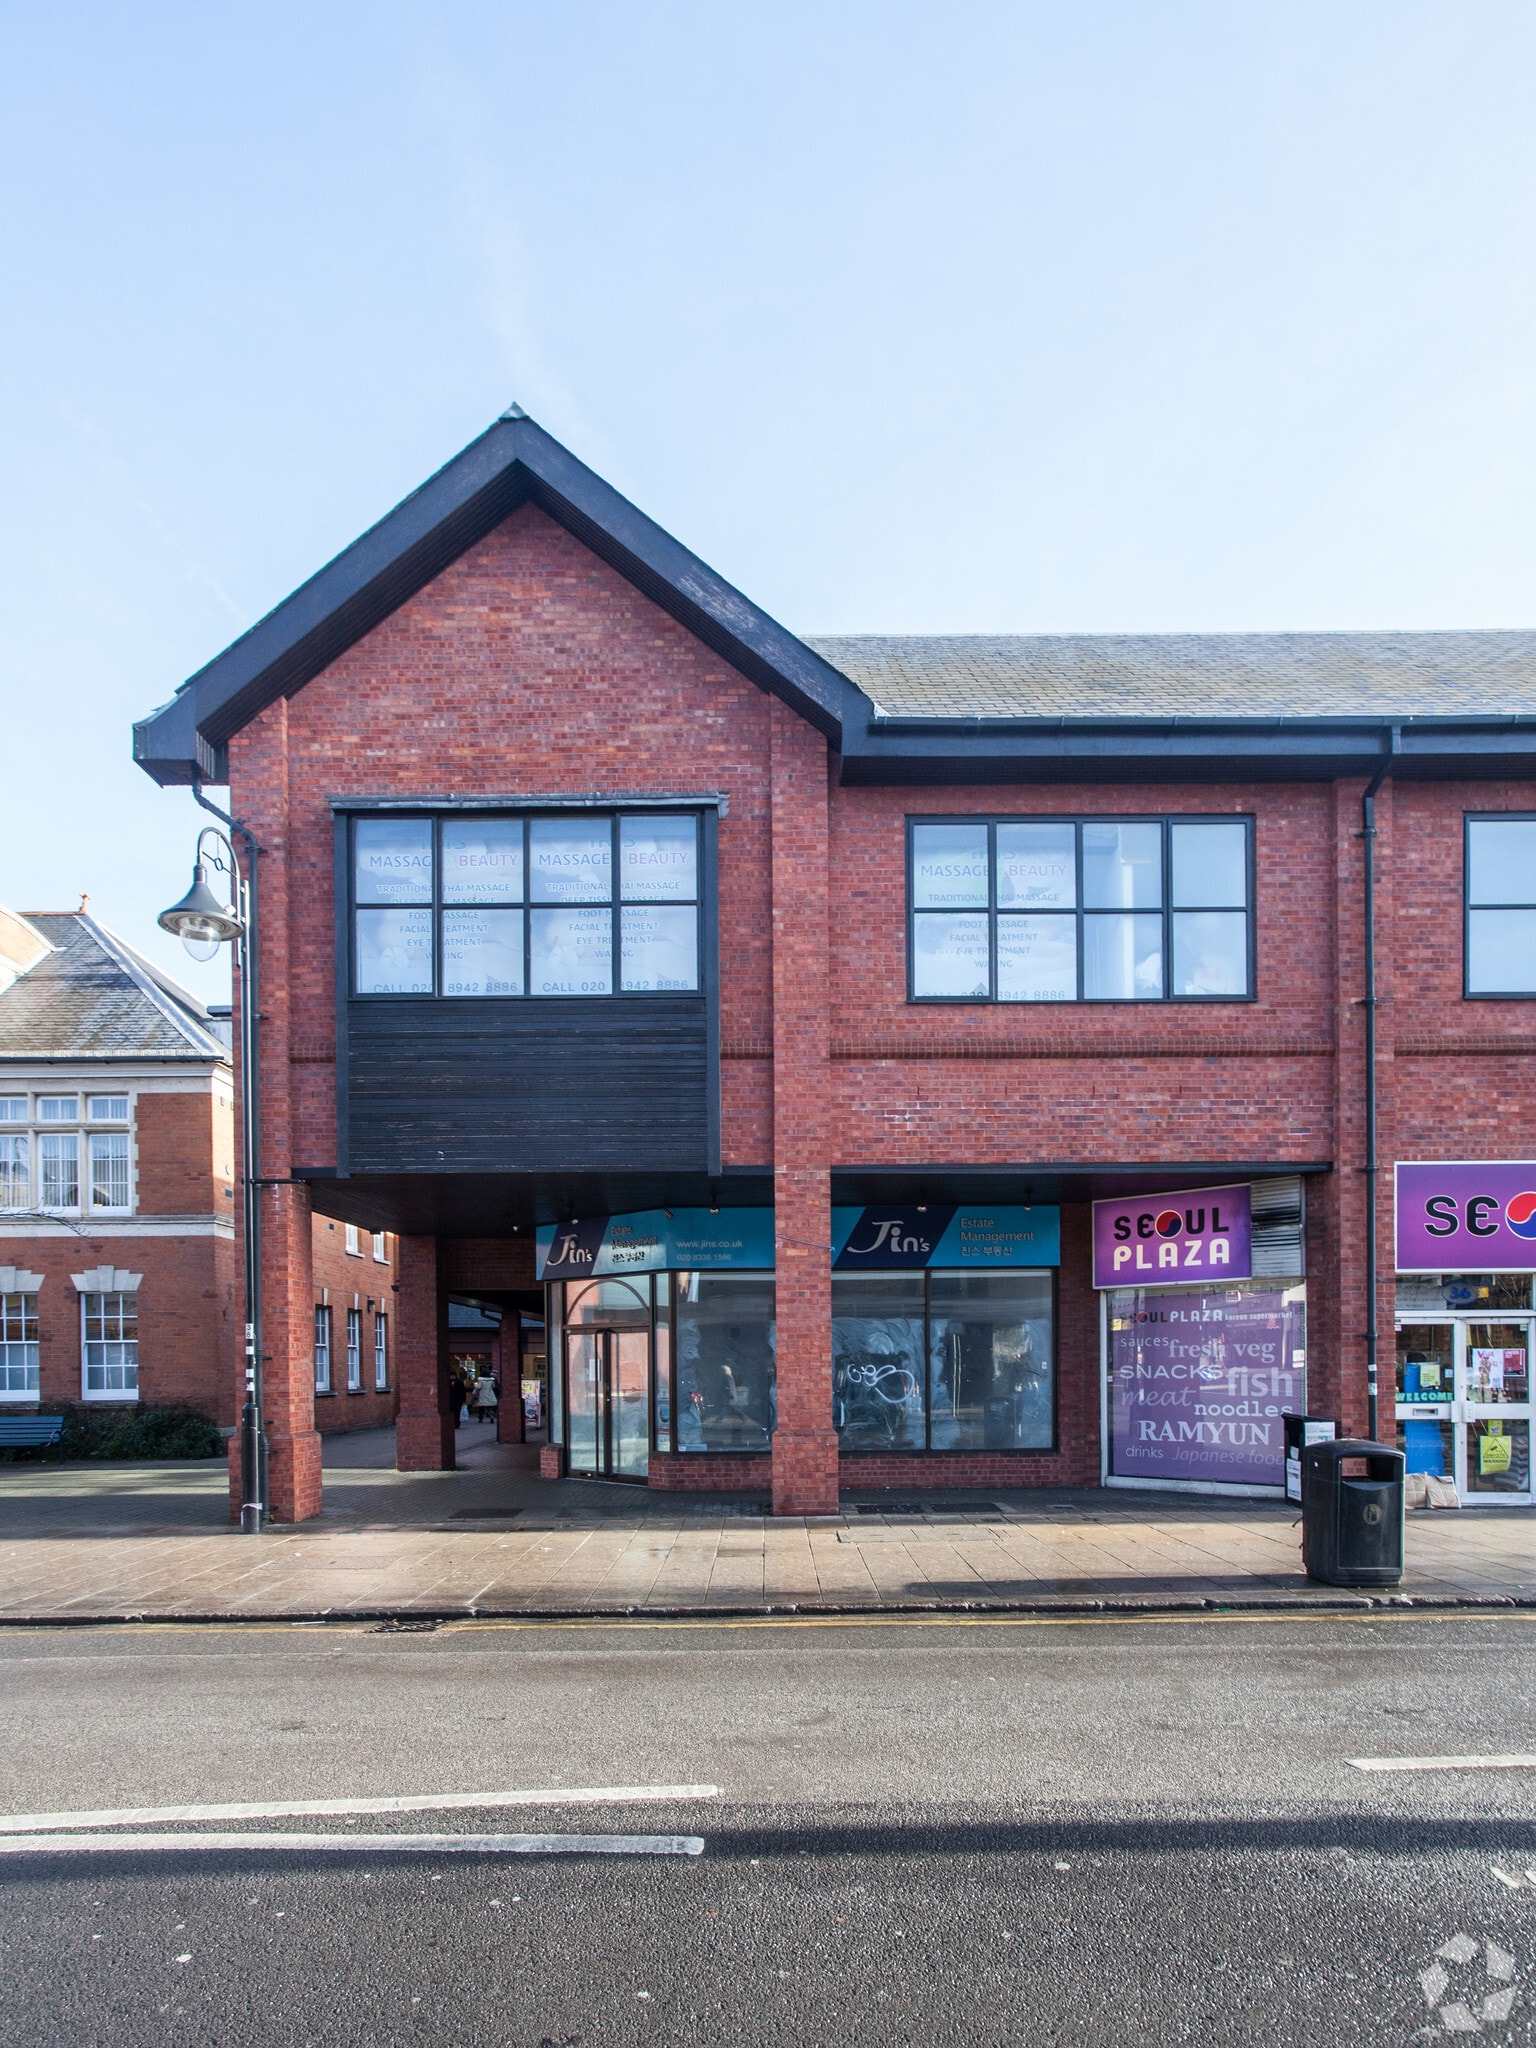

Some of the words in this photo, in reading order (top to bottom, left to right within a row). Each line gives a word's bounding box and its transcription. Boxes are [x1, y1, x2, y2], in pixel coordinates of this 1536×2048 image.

[370, 855, 432, 867] MASSAG
[459, 854, 518, 867] BEAUTY
[539, 853, 610, 866] MASSAGE
[629, 852, 688, 865] BEAUTY
[921, 865, 989, 877] MASSAGE
[1009, 864, 1066, 876] BEAUTY
[377, 885, 432, 894] TRADITIONA
[467, 884, 511, 892] MASSAGE
[546, 883, 608, 892] TRADITIONAL
[637, 881, 681, 890] MASSAGE
[928, 894, 989, 902] TRADITIONAL
[998, 894, 1015, 902] HAI
[1016, 894, 1060, 902] MASSAGE
[408, 911, 432, 920] FOOT
[443, 911, 479, 919] ASSAGE
[578, 910, 602, 918] FOOT
[605, 909, 649, 917] MSSAGE
[399, 925, 431, 934] FACIAL
[443, 925, 489, 933] EATMENT
[569, 923, 600, 932] FACIAL
[604, 923, 659, 931] TATMENT
[959, 920, 982, 928] FOOT
[576, 937, 593, 945] EYE
[597, 936, 652, 944] TRETMENT
[949, 933, 980, 941] FACIAL
[984, 932, 1038, 941] TEATMENT
[407, 939, 424, 947] EYE
[427, 938, 482, 947] TATMENT
[425, 952, 463, 960] WING
[976, 947, 1031, 955] TRATMENT
[975, 960, 1013, 968] WANG
[448, 982, 479, 993] 8942
[486, 982, 517, 992] 8886
[542, 983, 575, 992] CALL
[581, 982, 606, 992] 020
[656, 980, 688, 990] 8886
[1034, 990, 1065, 1000] 8886
[960, 1217, 994, 1228] Estate
[1114, 1207, 1229, 1240] SEOUL
[611, 1225, 632, 1236] Estate
[960, 1230, 1034, 1242] Management
[846, 1220, 930, 1253] Jin's
[547, 1233, 594, 1266] Jin's
[676, 1239, 743, 1249] www.jins.co.uk
[1113, 1238, 1229, 1271] PLAZA
[1450, 1286, 1471, 1300] 36
[1169, 1309, 1223, 1323] PLAZA
[1120, 1335, 1169, 1348] sauces
[1168, 1339, 1226, 1358] fresh
[1233, 1341, 1276, 1363] veg
[1120, 1364, 1224, 1379] SNACKS
[1227, 1366, 1294, 1397] fish
[1121, 1386, 1197, 1406] meat
[1395, 1392, 1454, 1402] WELCOME
[1194, 1400, 1294, 1418] noodles
[1138, 1420, 1272, 1446] RAMYUN
[1125, 1445, 1165, 1459] drinks
[1172, 1447, 1244, 1464] Japanese
